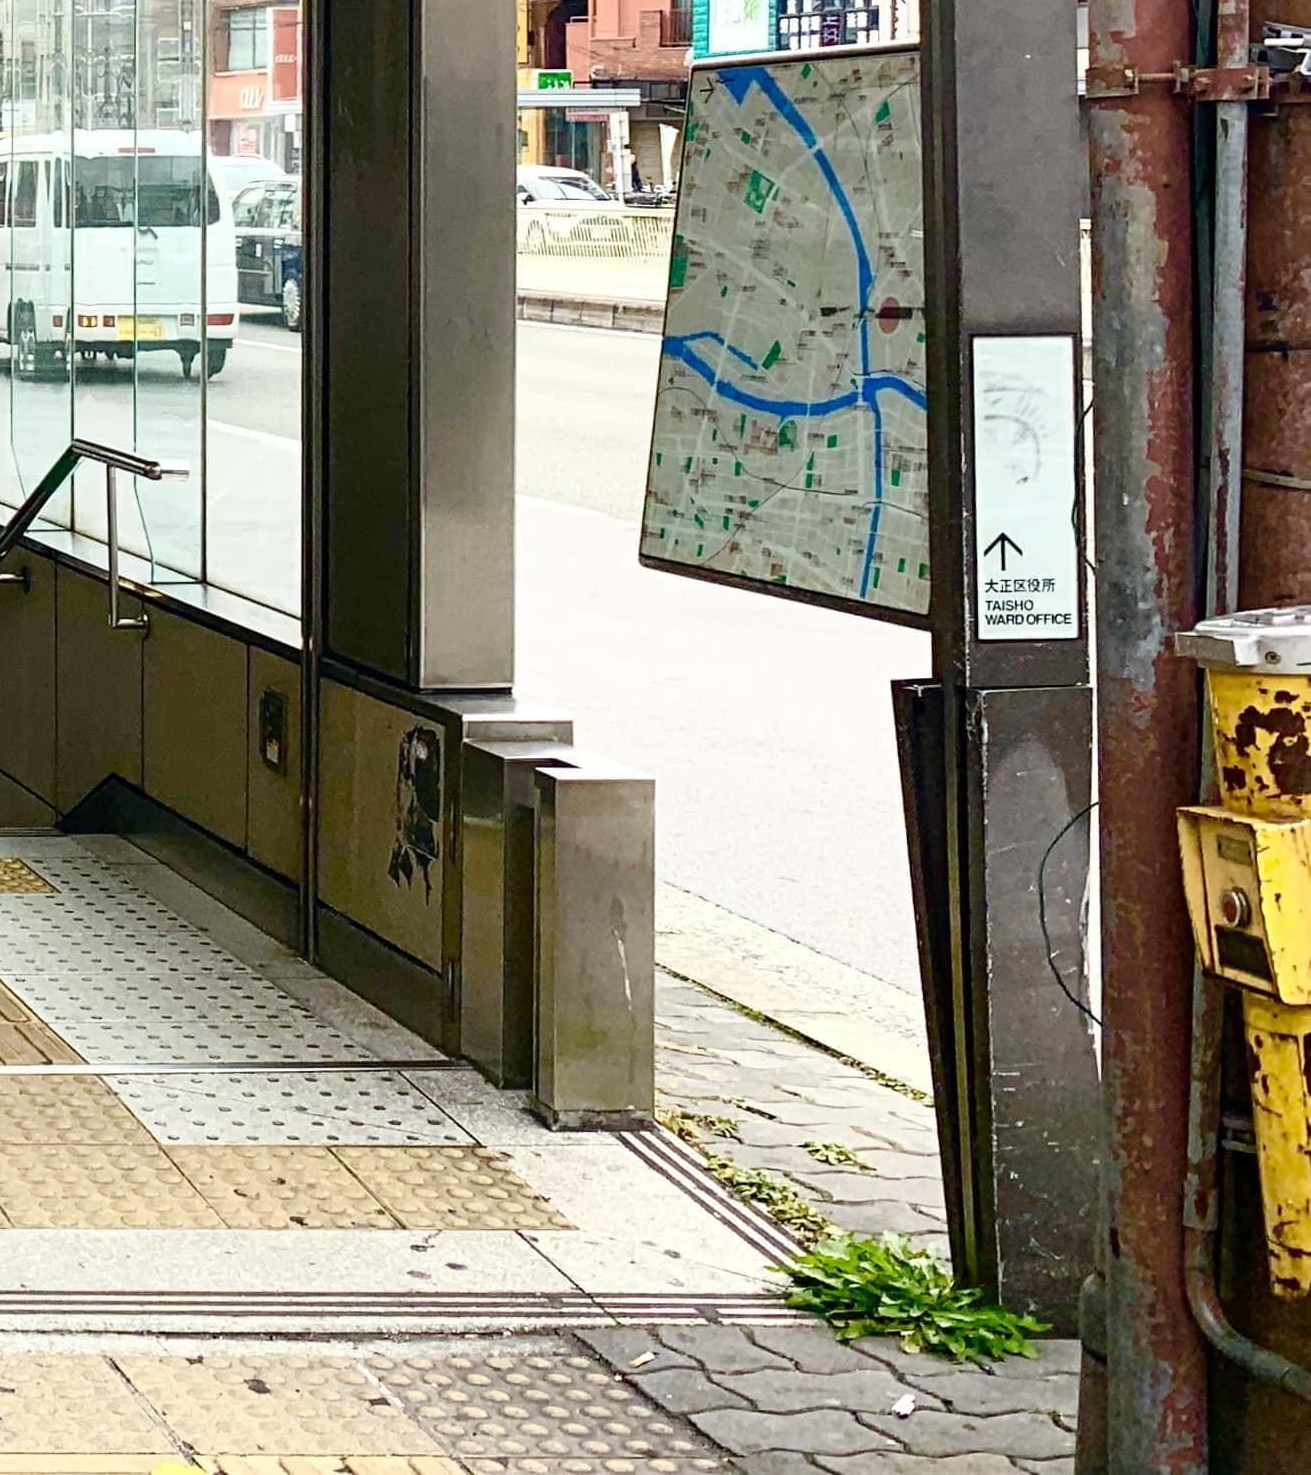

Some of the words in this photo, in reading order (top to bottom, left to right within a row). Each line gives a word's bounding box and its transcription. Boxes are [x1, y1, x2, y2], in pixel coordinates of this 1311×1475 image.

[984, 578, 1056, 594] 大正区役所
[985, 599, 1035, 612] TAISHO
[985, 613, 1025, 626] WARD
[1026, 612, 1073, 626] OFFICE
